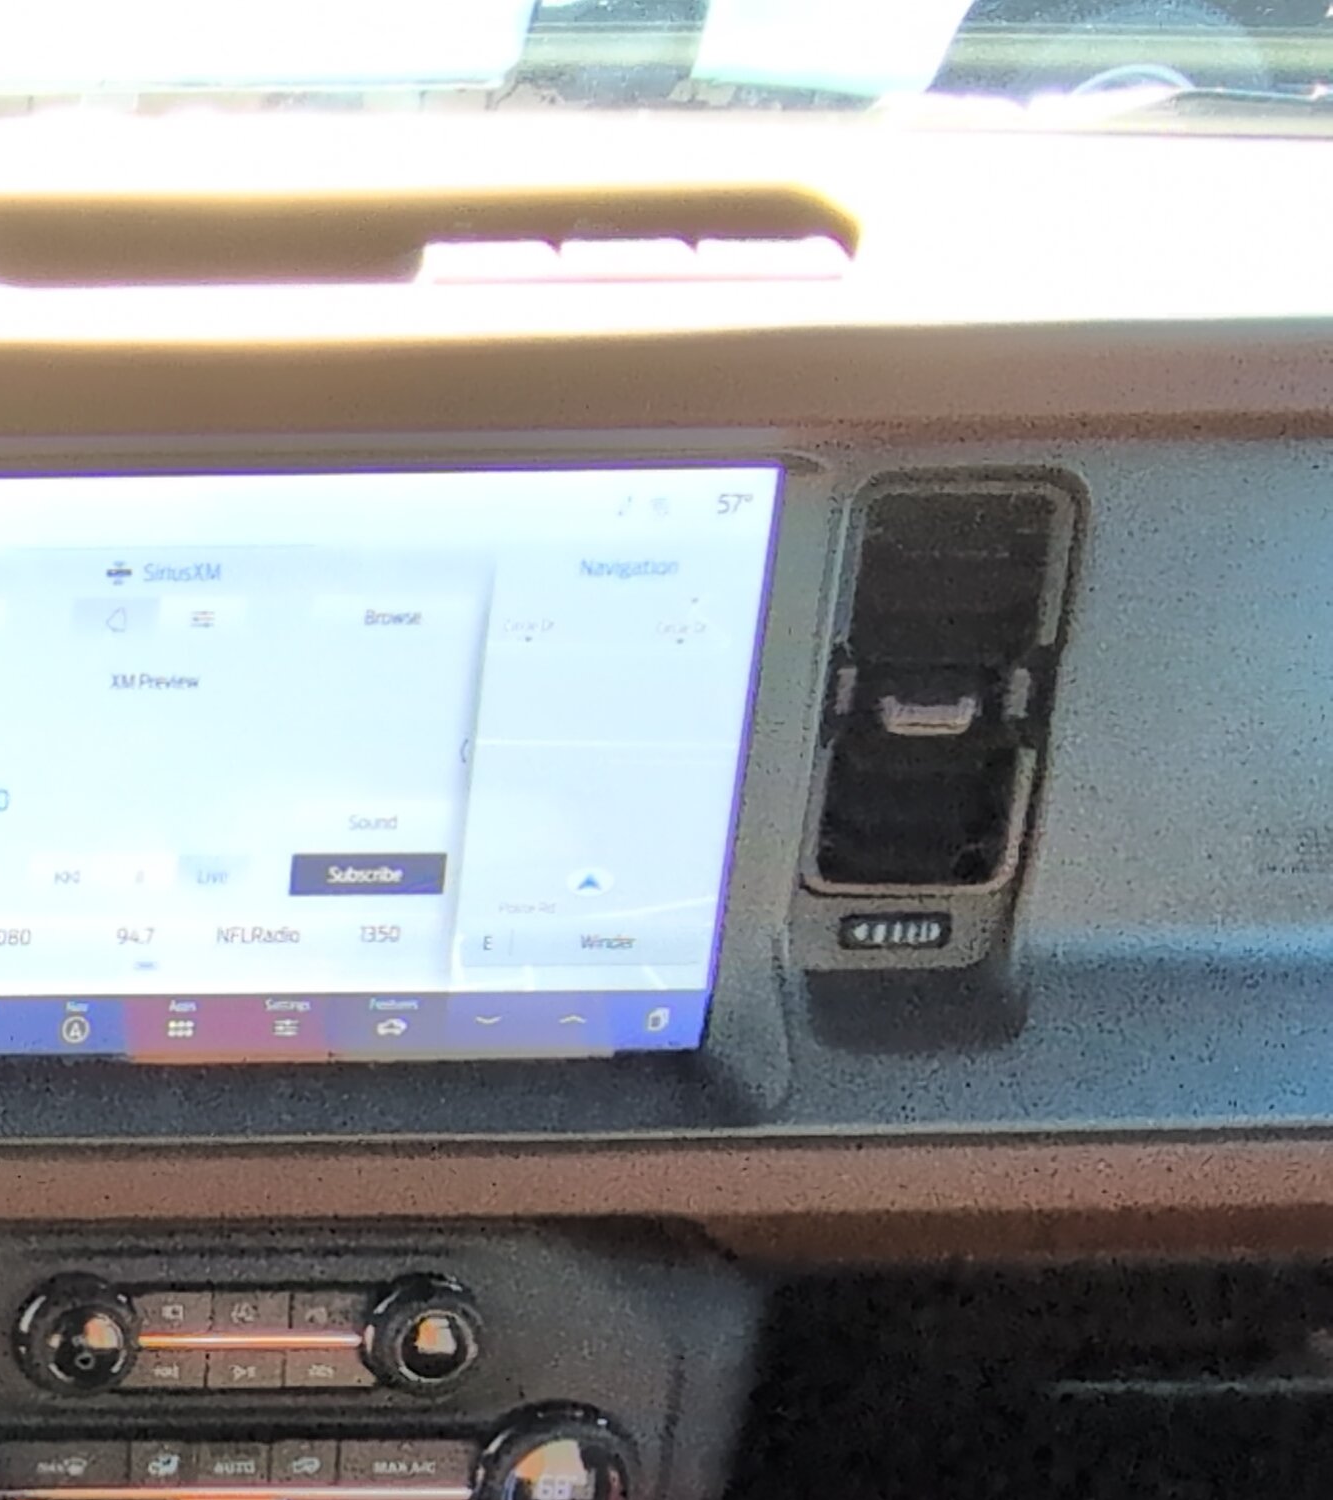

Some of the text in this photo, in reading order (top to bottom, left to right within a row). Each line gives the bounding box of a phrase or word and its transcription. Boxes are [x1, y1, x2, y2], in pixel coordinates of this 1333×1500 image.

[716, 493, 754, 515] 57°
[142, 562, 222, 584] SiriusXM
[579, 558, 679, 578] Navigation
[363, 609, 422, 627] Browse
[109, 673, 200, 691] XM Preview
[348, 814, 398, 832] Sound
[196, 868, 228, 885] Live
[326, 865, 405, 885] Subscribe
[116, 928, 157, 946] 94.7
[359, 926, 401, 944] 1350
[482, 935, 493, 952] E
[580, 933, 638, 951] Winder
[213, 1460, 256, 1475] AUTO
